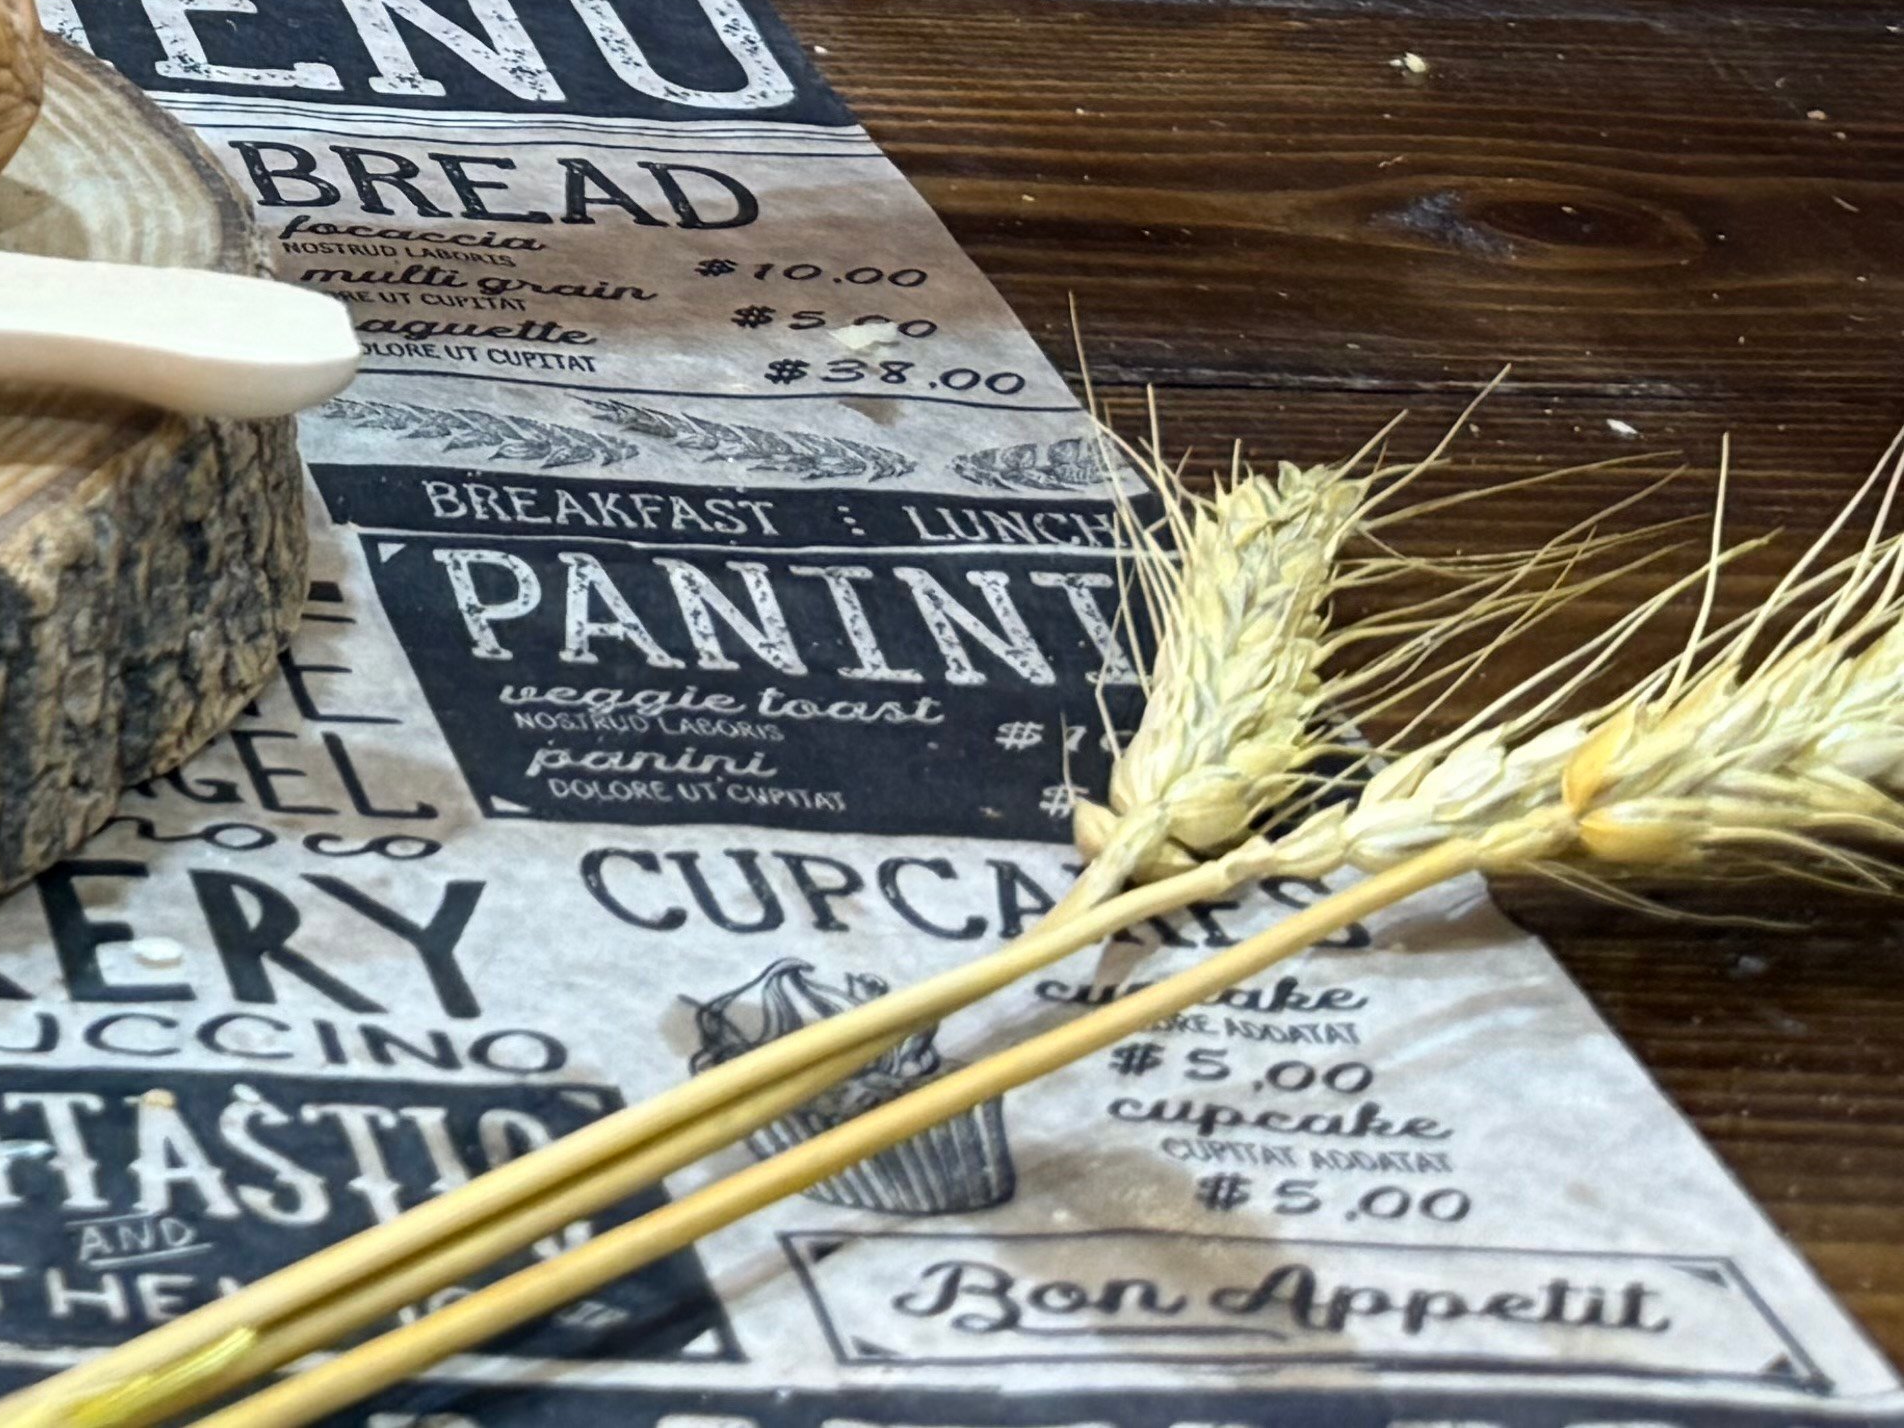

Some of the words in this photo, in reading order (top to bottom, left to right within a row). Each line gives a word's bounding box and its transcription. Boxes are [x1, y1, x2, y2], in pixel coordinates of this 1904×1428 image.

[228, 140, 759, 230] BREAD
[278, 215, 546, 250] focaccia
[283, 242, 397, 259] NOSTRUD
[405, 246, 517, 269] LABORIS
[694, 258, 928, 288] $10.00
[300, 263, 468, 288] multi
[478, 274, 657, 301] grain
[381, 291, 411, 306] UT
[420, 294, 527, 313] CUPITAT
[354, 316, 598, 346] aguette
[445, 345, 479, 362] UT
[487, 347, 597, 374] CUPITAT
[764, 357, 1026, 396] $38.00
[422, 479, 780, 537] BREAKFAST
[901, 505, 1128, 549] LUNCH
[499, 684, 747, 716] veggie
[758, 687, 944, 725] toast
[513, 711, 650, 734] NOSTRUD
[659, 717, 785, 743] LABORIS
[525, 744, 778, 778] panini
[548, 779, 674, 802] DOLORE
[726, 784, 847, 813] CUPITAT
[1034, 975, 1370, 1012] cuake
[1225, 1016, 1362, 1046] ADDATAT
[1106, 1095, 1455, 1141] cupcake
[1161, 1136, 1298, 1168] CUPITAT
[1311, 1149, 1454, 1175] ADDATAT
[77, 1218, 198, 1262] AND
[892, 1258, 1190, 1341] Bon
[1209, 1260, 1674, 1335] Appetit
